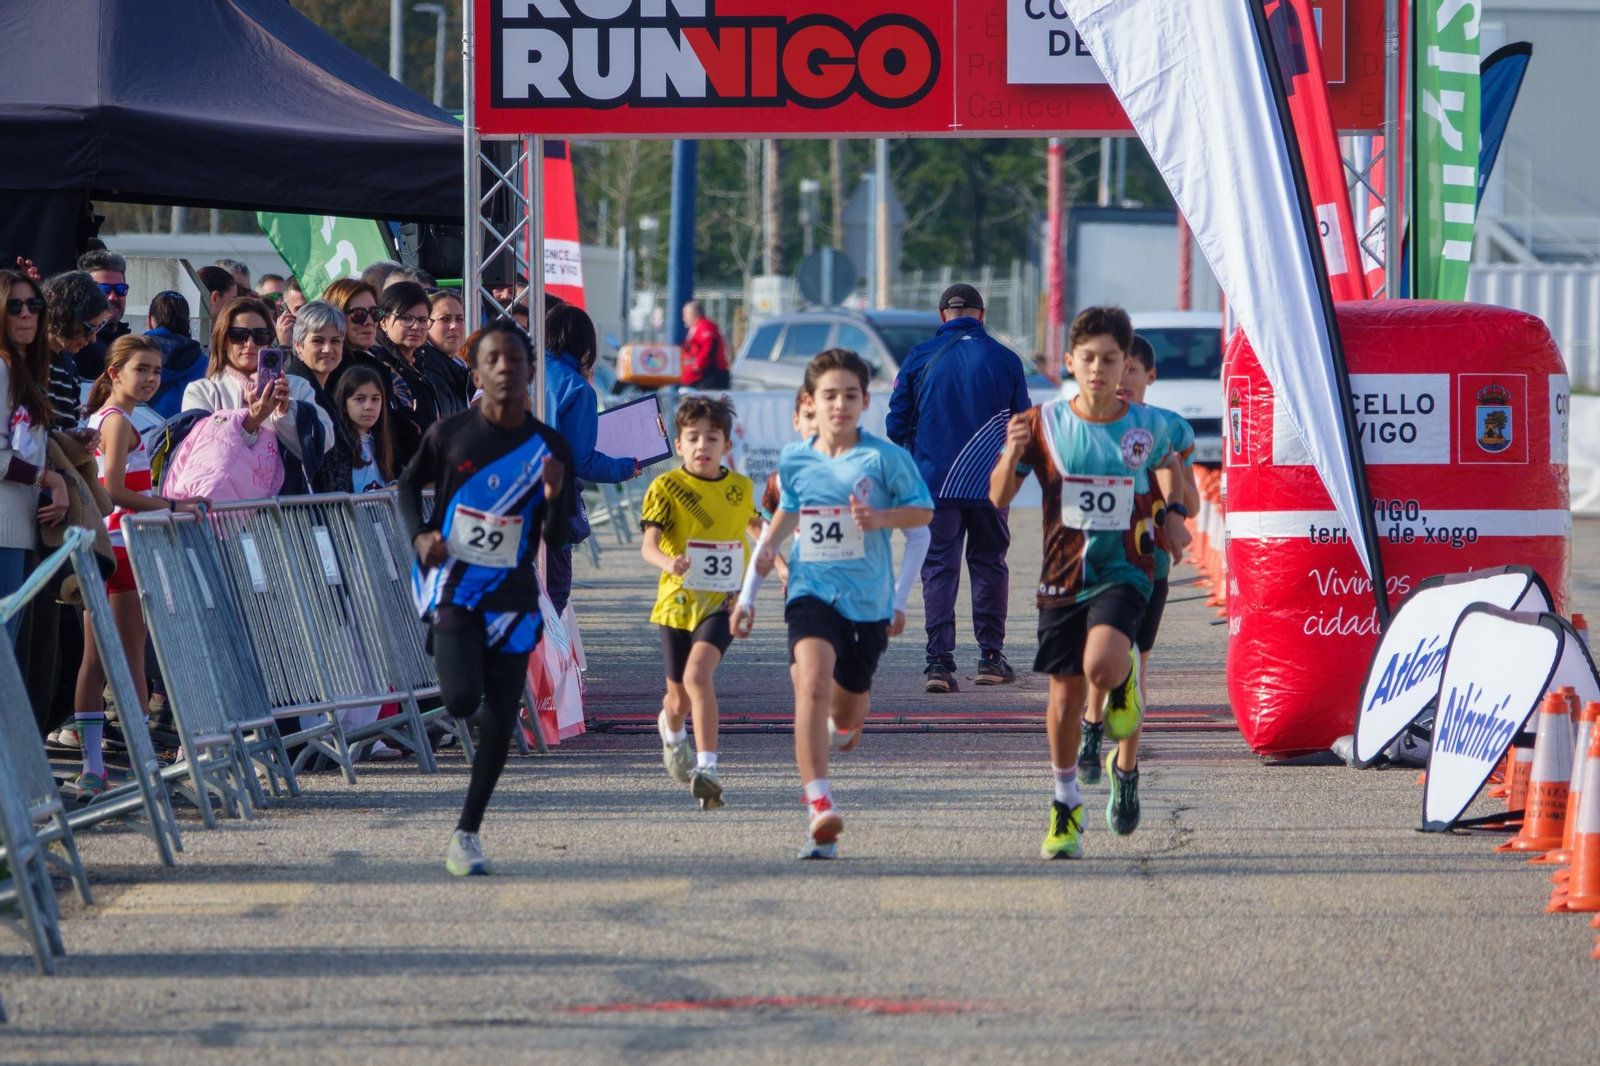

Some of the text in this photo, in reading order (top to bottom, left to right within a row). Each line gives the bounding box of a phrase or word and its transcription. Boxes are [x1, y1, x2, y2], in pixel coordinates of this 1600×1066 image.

[1079, 490, 1116, 513] 30
[1374, 499, 1427, 525] IGO,
[468, 526, 504, 551] 29
[810, 521, 844, 544] 34
[1388, 522, 1415, 544] de
[1424, 526, 1479, 548] xogo
[703, 556, 732, 576] 33
[1303, 607, 1382, 636] cidad
[1435, 682, 1516, 763] Atlántico
